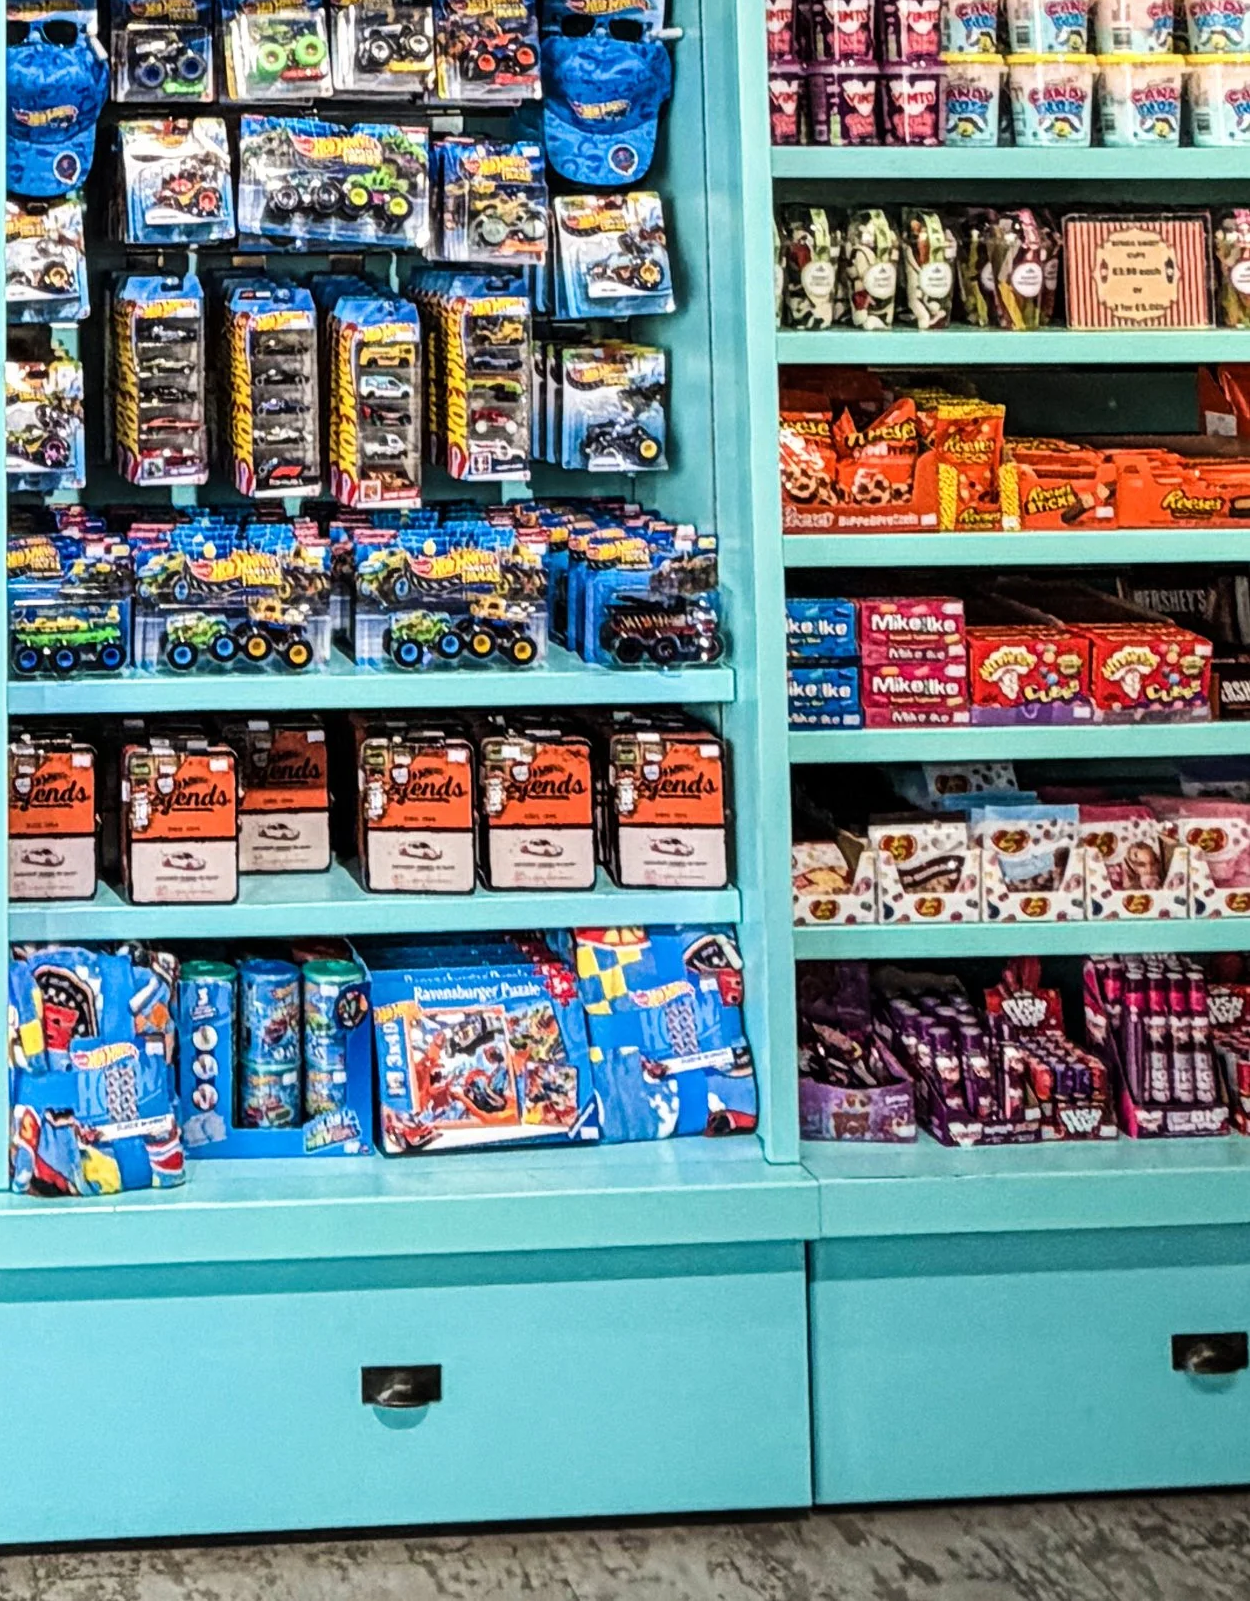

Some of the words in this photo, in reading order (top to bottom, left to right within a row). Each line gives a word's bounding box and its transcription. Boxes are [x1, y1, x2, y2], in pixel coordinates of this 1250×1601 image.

[1139, 267, 1162, 276] each
[870, 614, 922, 632] Mike
[926, 616, 957, 633] Ike
[872, 676, 925, 694] Mike
[928, 678, 959, 696] Ike
[413, 984, 499, 1003] Ravensburger
[499, 981, 541, 999] Puzzle
